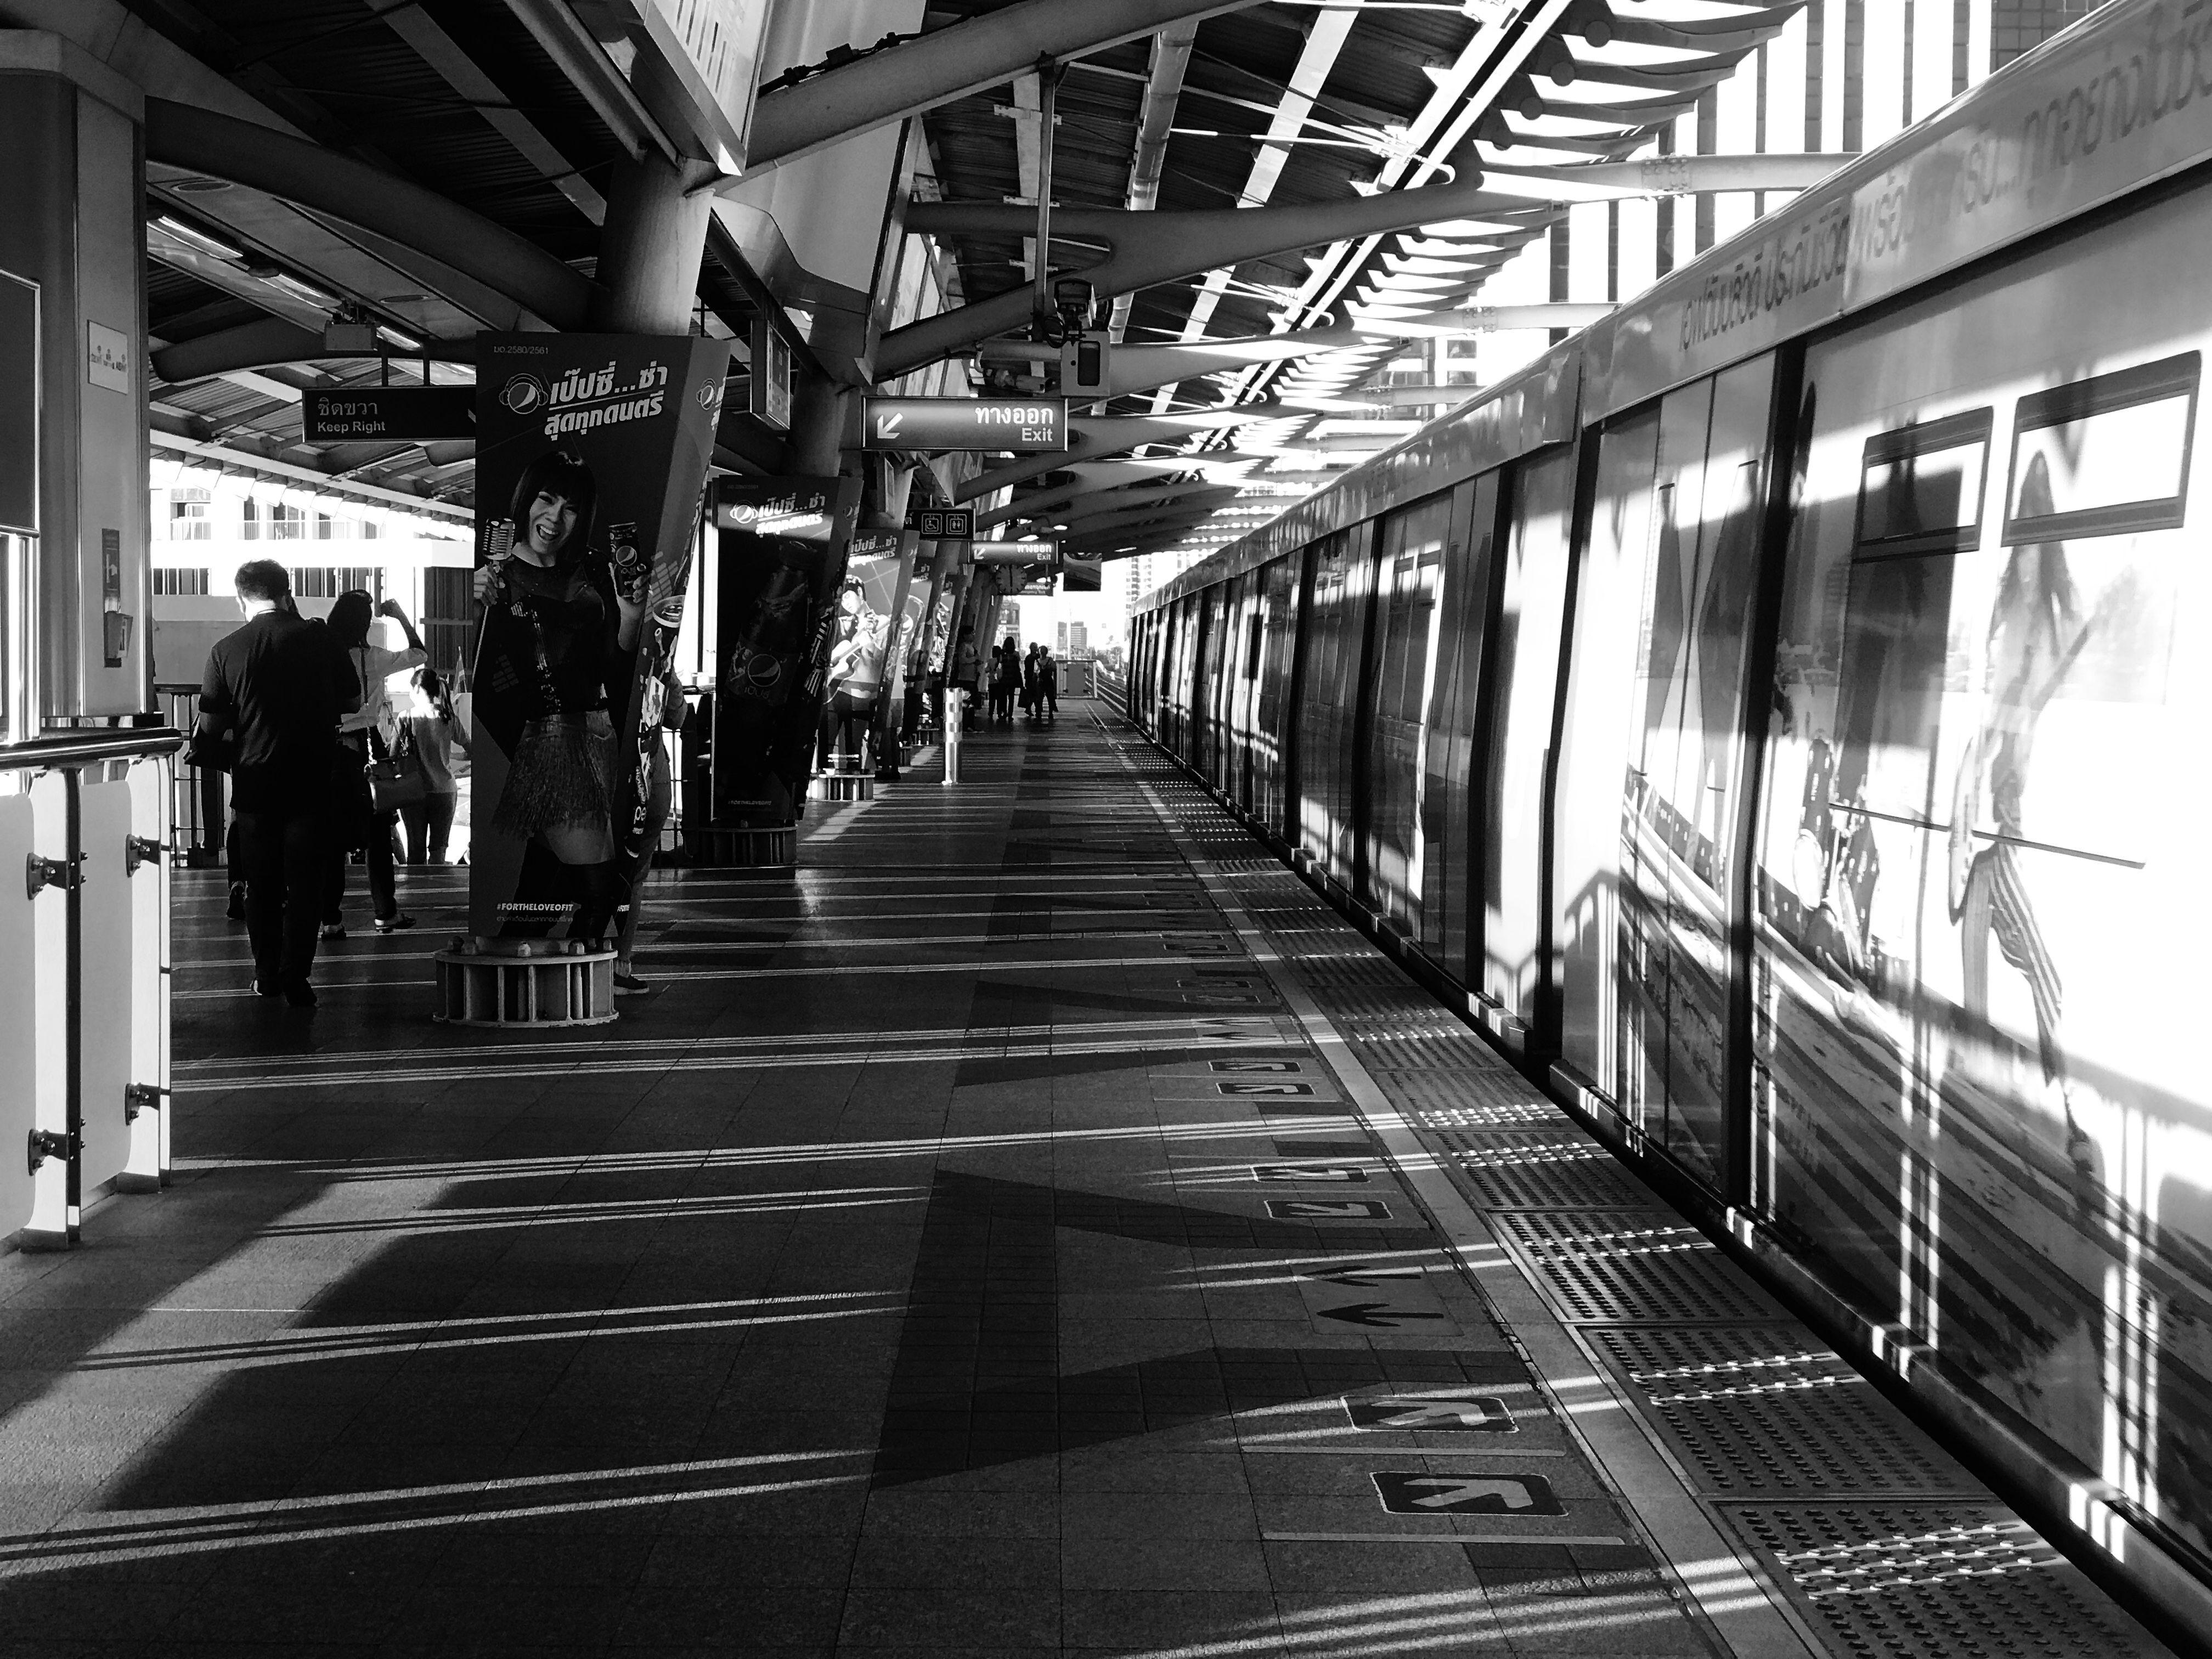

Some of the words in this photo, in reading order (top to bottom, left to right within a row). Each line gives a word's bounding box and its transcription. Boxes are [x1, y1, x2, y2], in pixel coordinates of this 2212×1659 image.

[318, 397, 378, 416] ชิดขวา
[544, 390, 664, 441] สุดทุกดนตรี
[975, 407, 1053, 424] ทางออก
[317, 421, 348, 434] Keep
[353, 420, 386, 433] Right
[1022, 427, 1053, 442] Exit
[1016, 544, 1052, 553] ทางออก
[496, 902, 574, 911] #FORTHELOVEOFIT
